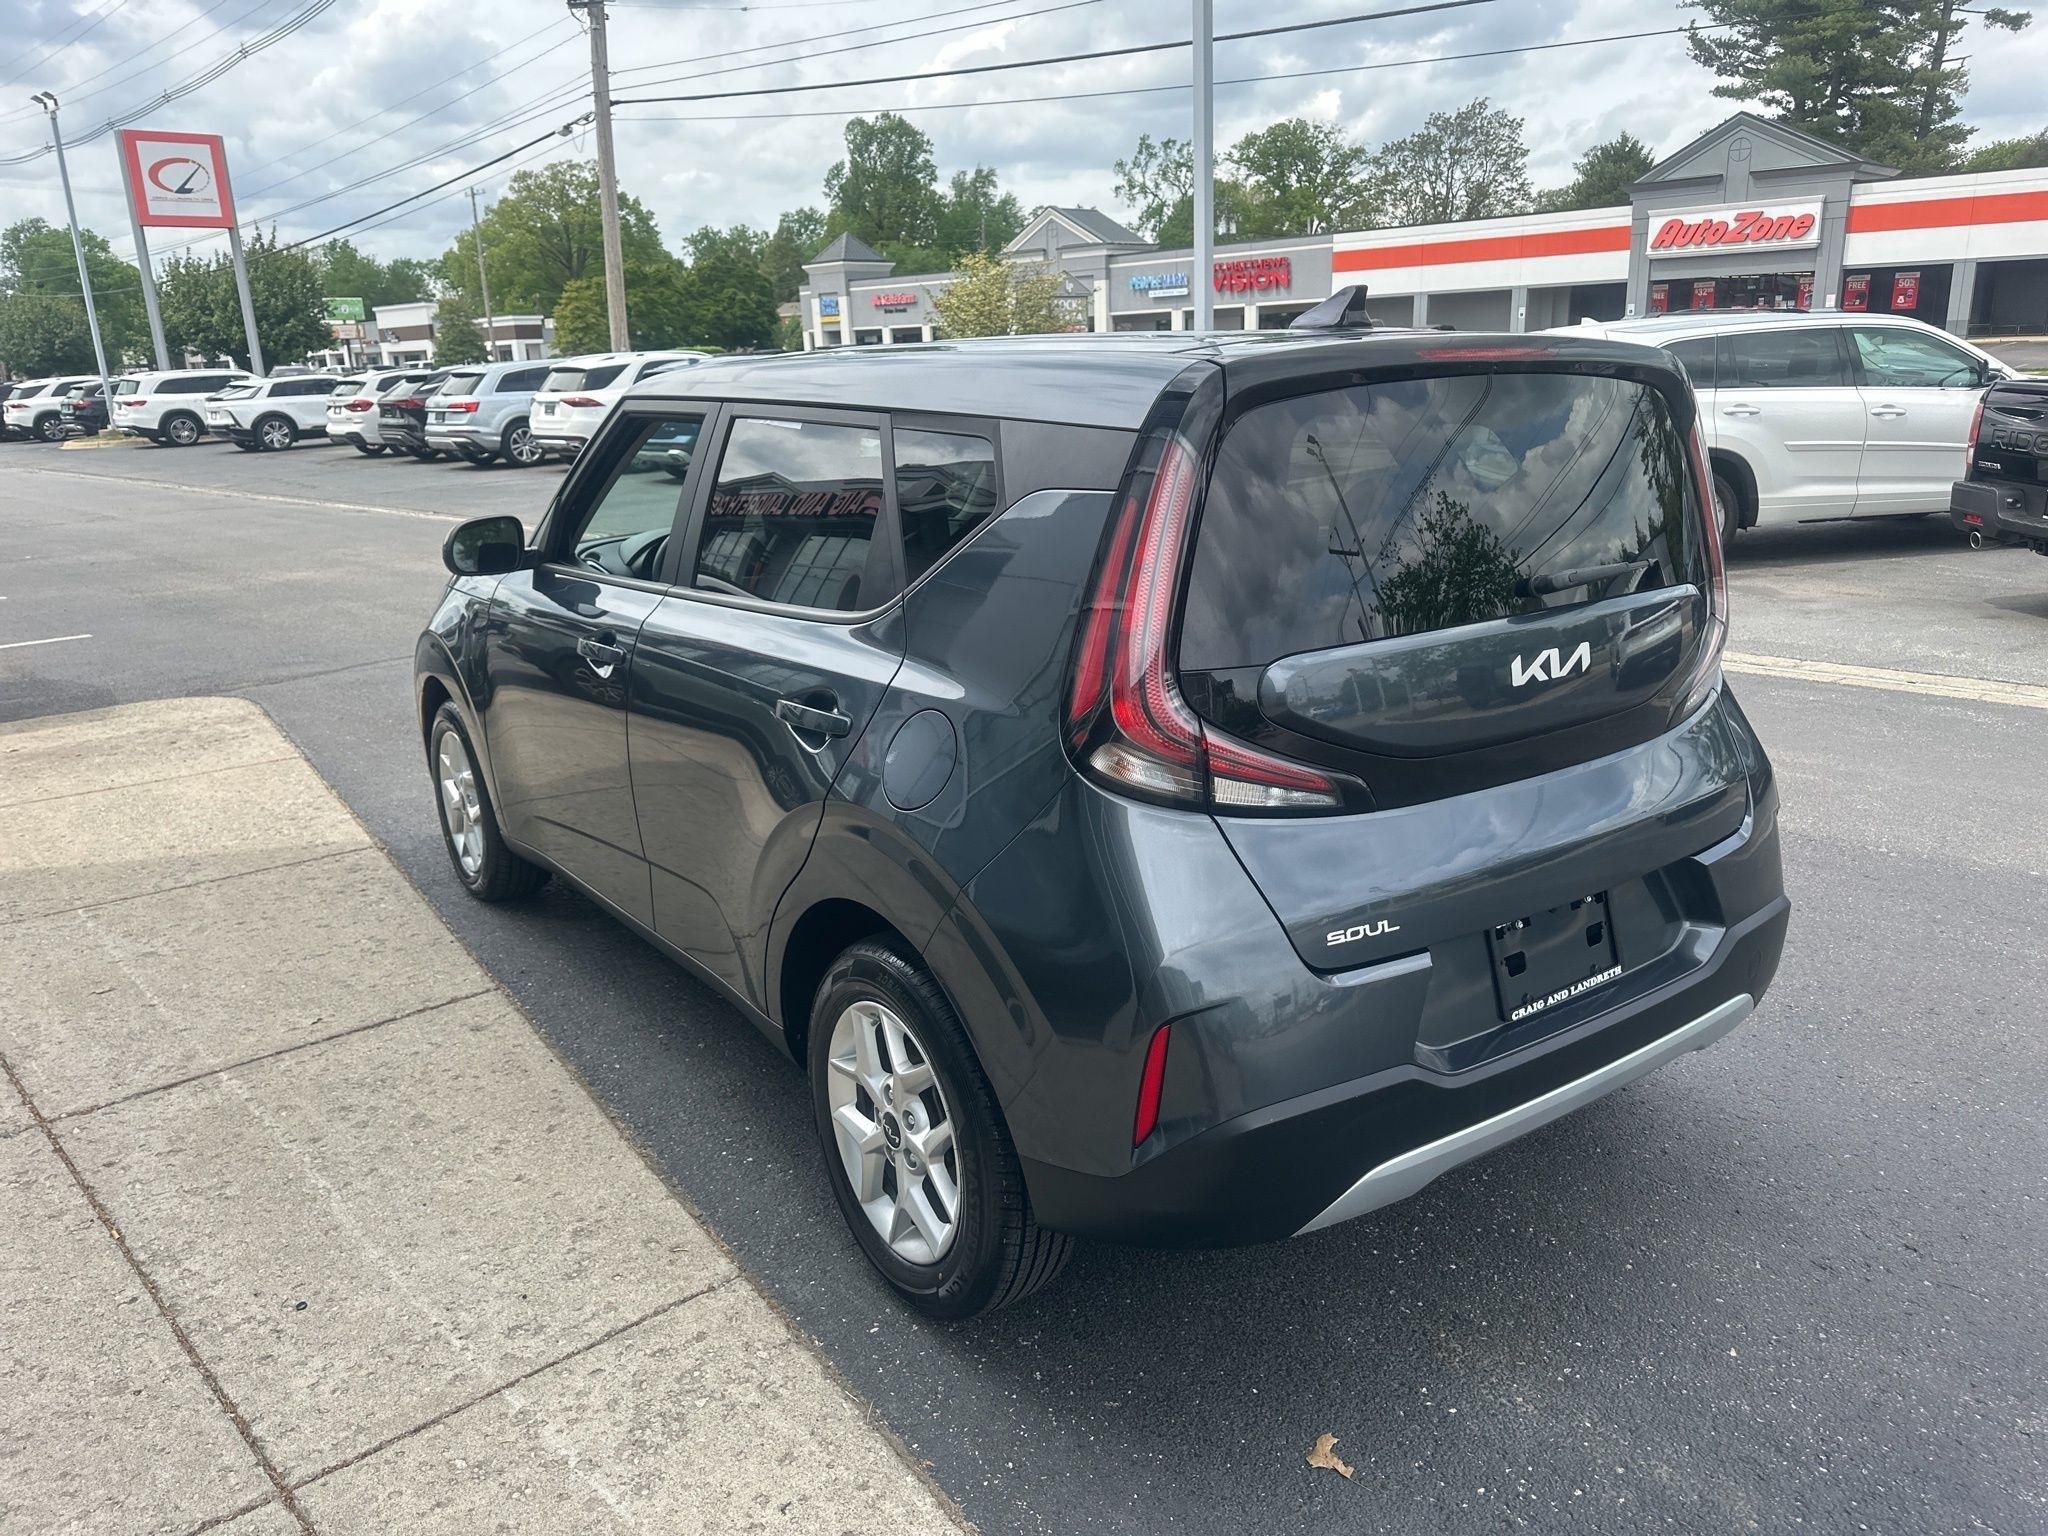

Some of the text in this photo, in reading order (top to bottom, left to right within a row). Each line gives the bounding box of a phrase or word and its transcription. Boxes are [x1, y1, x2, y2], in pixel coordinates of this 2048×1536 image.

[1650, 210, 1816, 250] AutoZone
[1213, 268, 1291, 293] VISION
[1848, 281, 1867, 289] FREE
[1652, 292, 1665, 300] REE
[1511, 641, 1591, 687] KIA
[1326, 919, 1400, 946] SOUL
[1511, 965, 1622, 1021] CRAIG AND LANDRETH
